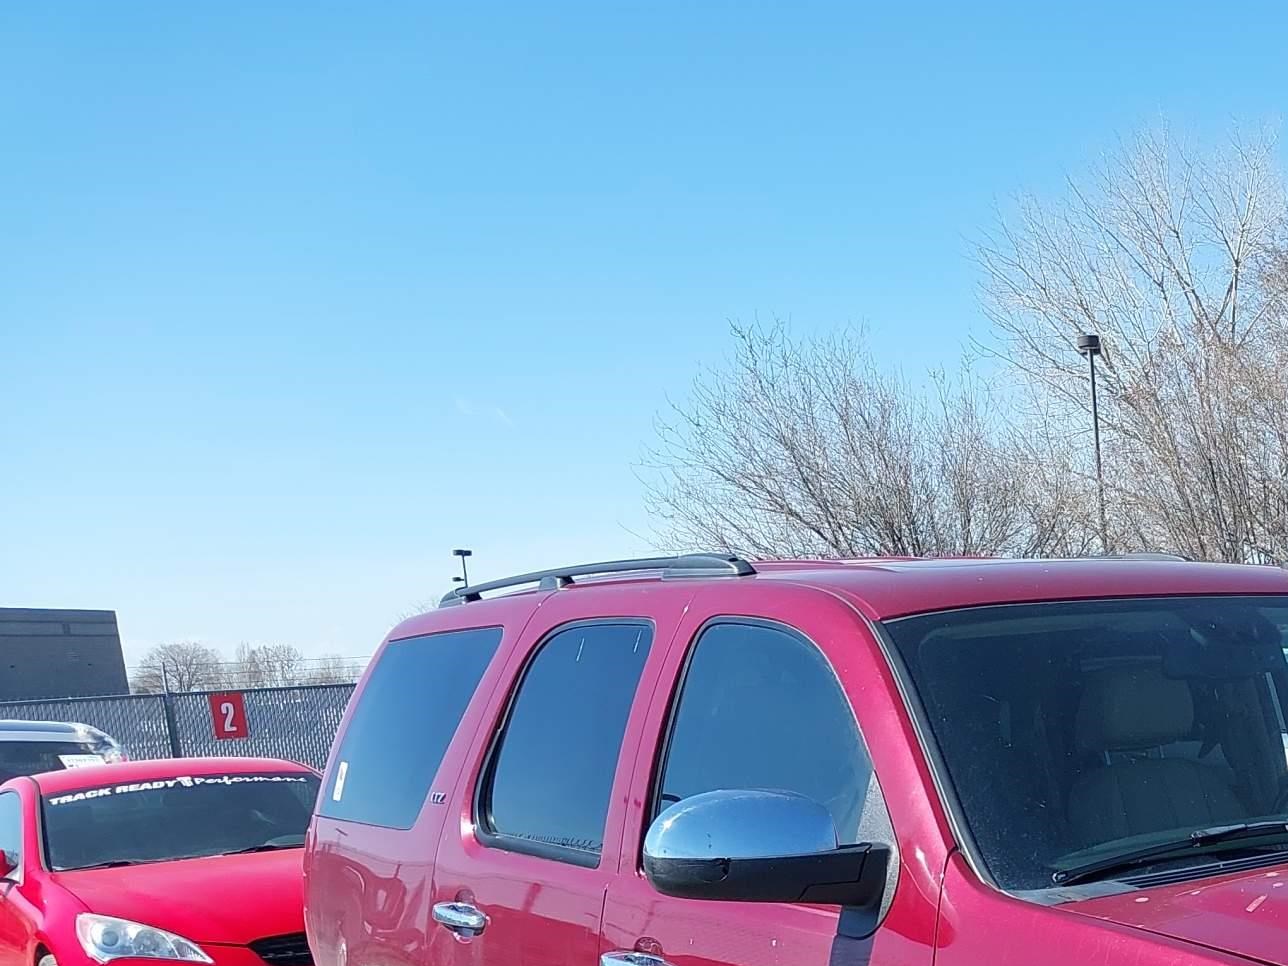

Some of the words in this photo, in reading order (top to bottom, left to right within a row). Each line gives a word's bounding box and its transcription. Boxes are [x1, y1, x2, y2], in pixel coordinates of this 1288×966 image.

[221, 702, 237, 732] 2
[49, 787, 112, 806] TRACK
[115, 780, 174, 794] READY
